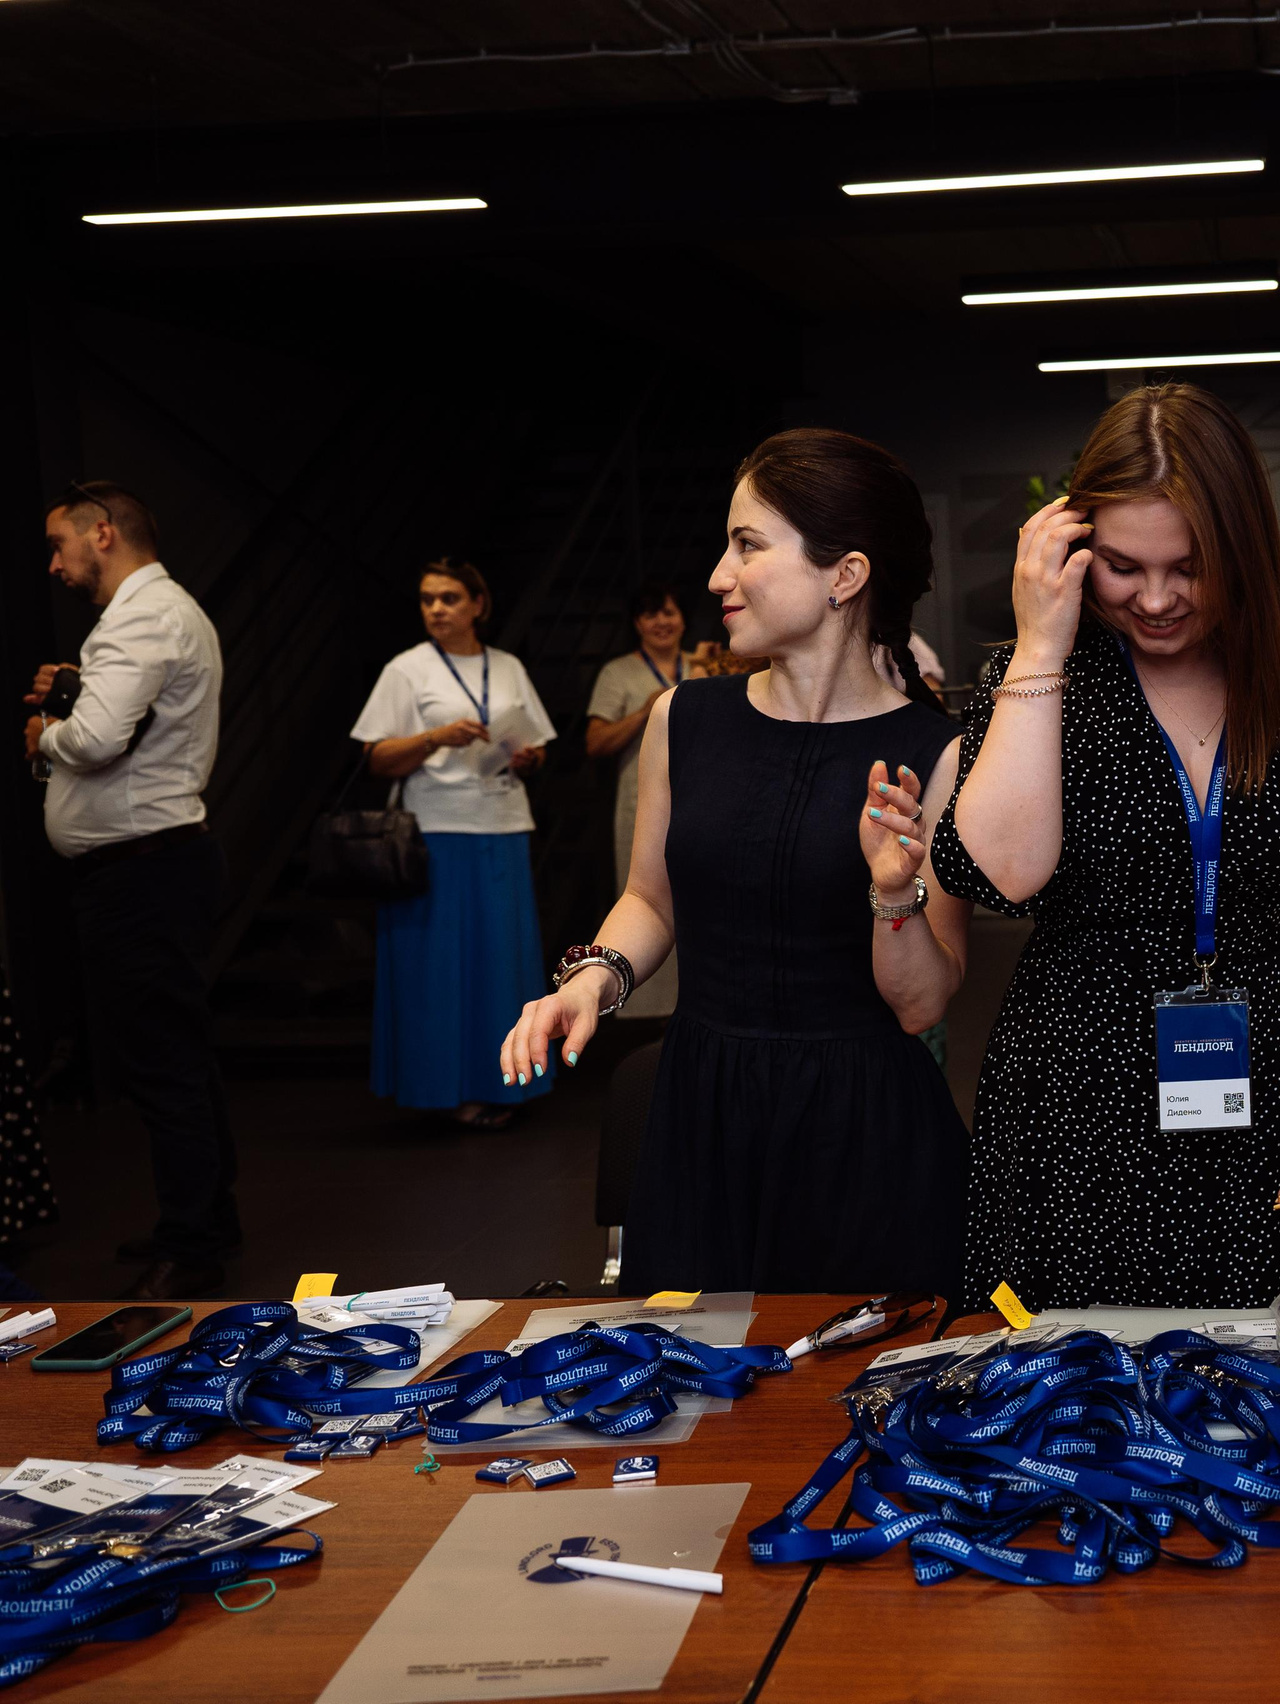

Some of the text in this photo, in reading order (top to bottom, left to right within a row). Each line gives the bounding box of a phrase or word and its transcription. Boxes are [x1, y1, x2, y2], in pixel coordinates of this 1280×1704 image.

[1178, 770, 1197, 822] ЛЕНДЛОРД
[1211, 766, 1226, 817] ЛЕНДЛОРД
[1205, 860, 1217, 914] ЛЕНДЛОРД
[1174, 1042, 1234, 1053] ЛЕНДЛОРД
[1166, 1095, 1189, 1103] Юлия
[1167, 1109, 1202, 1117] Диденко
[252, 1305, 293, 1318] НДЛОРД
[545, 1363, 608, 1386] ЛЕНДЛОРД
[1044, 1367, 1089, 1387] ЛЕНДЛОРД
[395, 1384, 457, 1405] ЛЕНДЛОРД
[467, 1375, 508, 1406] ЛЕНДЛОРД
[167, 1396, 224, 1412] ЛЕНДЛОРД
[161, 1431, 203, 1443] ЛЕНДЛ
[1184, 1432, 1247, 1458] ЛЕНДЛОРД
[1125, 1445, 1185, 1467] ЛЕНДЛОРД
[1018, 1457, 1078, 1482] ЛЕНДЛОРД
[1131, 1486, 1199, 1516] ЛЕНДЛОРД
[1204, 1496, 1258, 1541] ЛЕНДЛОРД
[0, 1598, 75, 1614] ЛЕНДЛОР
